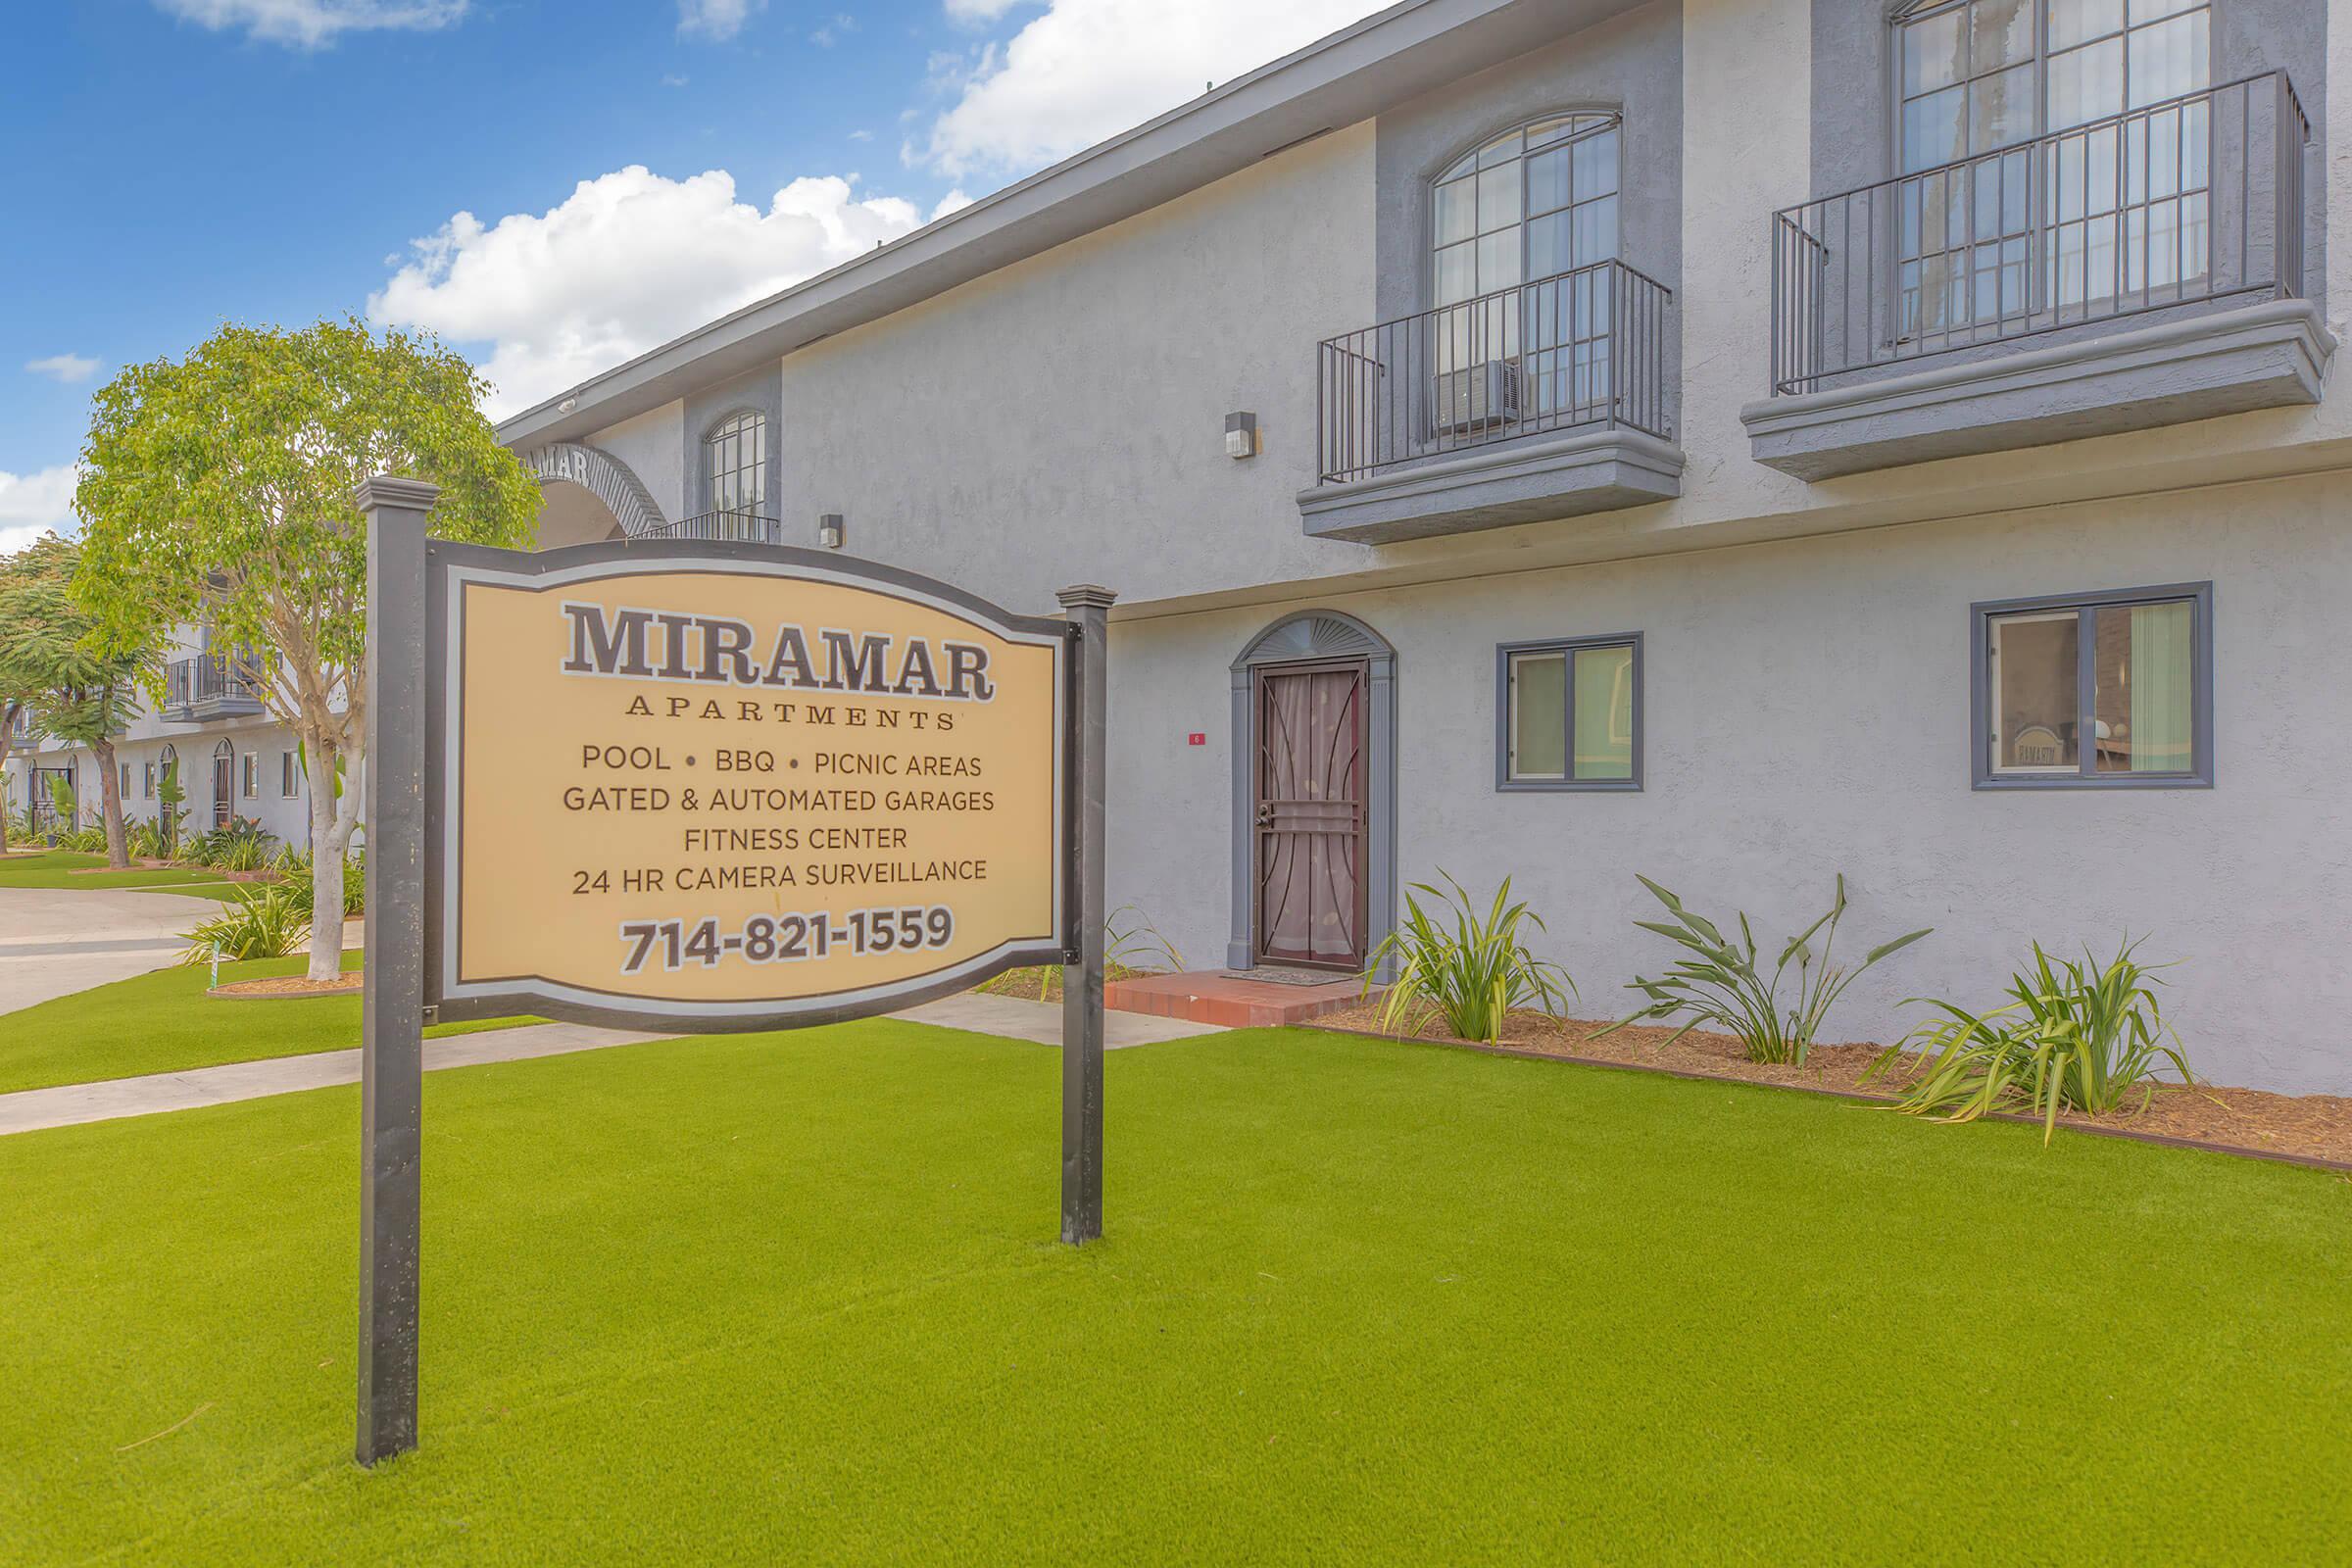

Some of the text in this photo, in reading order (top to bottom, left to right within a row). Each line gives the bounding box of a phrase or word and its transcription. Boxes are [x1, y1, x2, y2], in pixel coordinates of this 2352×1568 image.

[564, 604, 994, 701] MIRAMAR
[625, 695, 954, 731] APARTMENTS
[583, 746, 983, 778] POOL BBQ PICNIC AREAS
[564, 787, 995, 812] GATED & AUTOMATED GARAGES
[686, 828, 907, 853] FITNESS CENTER
[573, 860, 989, 896] 24 HR CAMERA SURVEILLANCE
[623, 907, 952, 971] 714-821-1559
